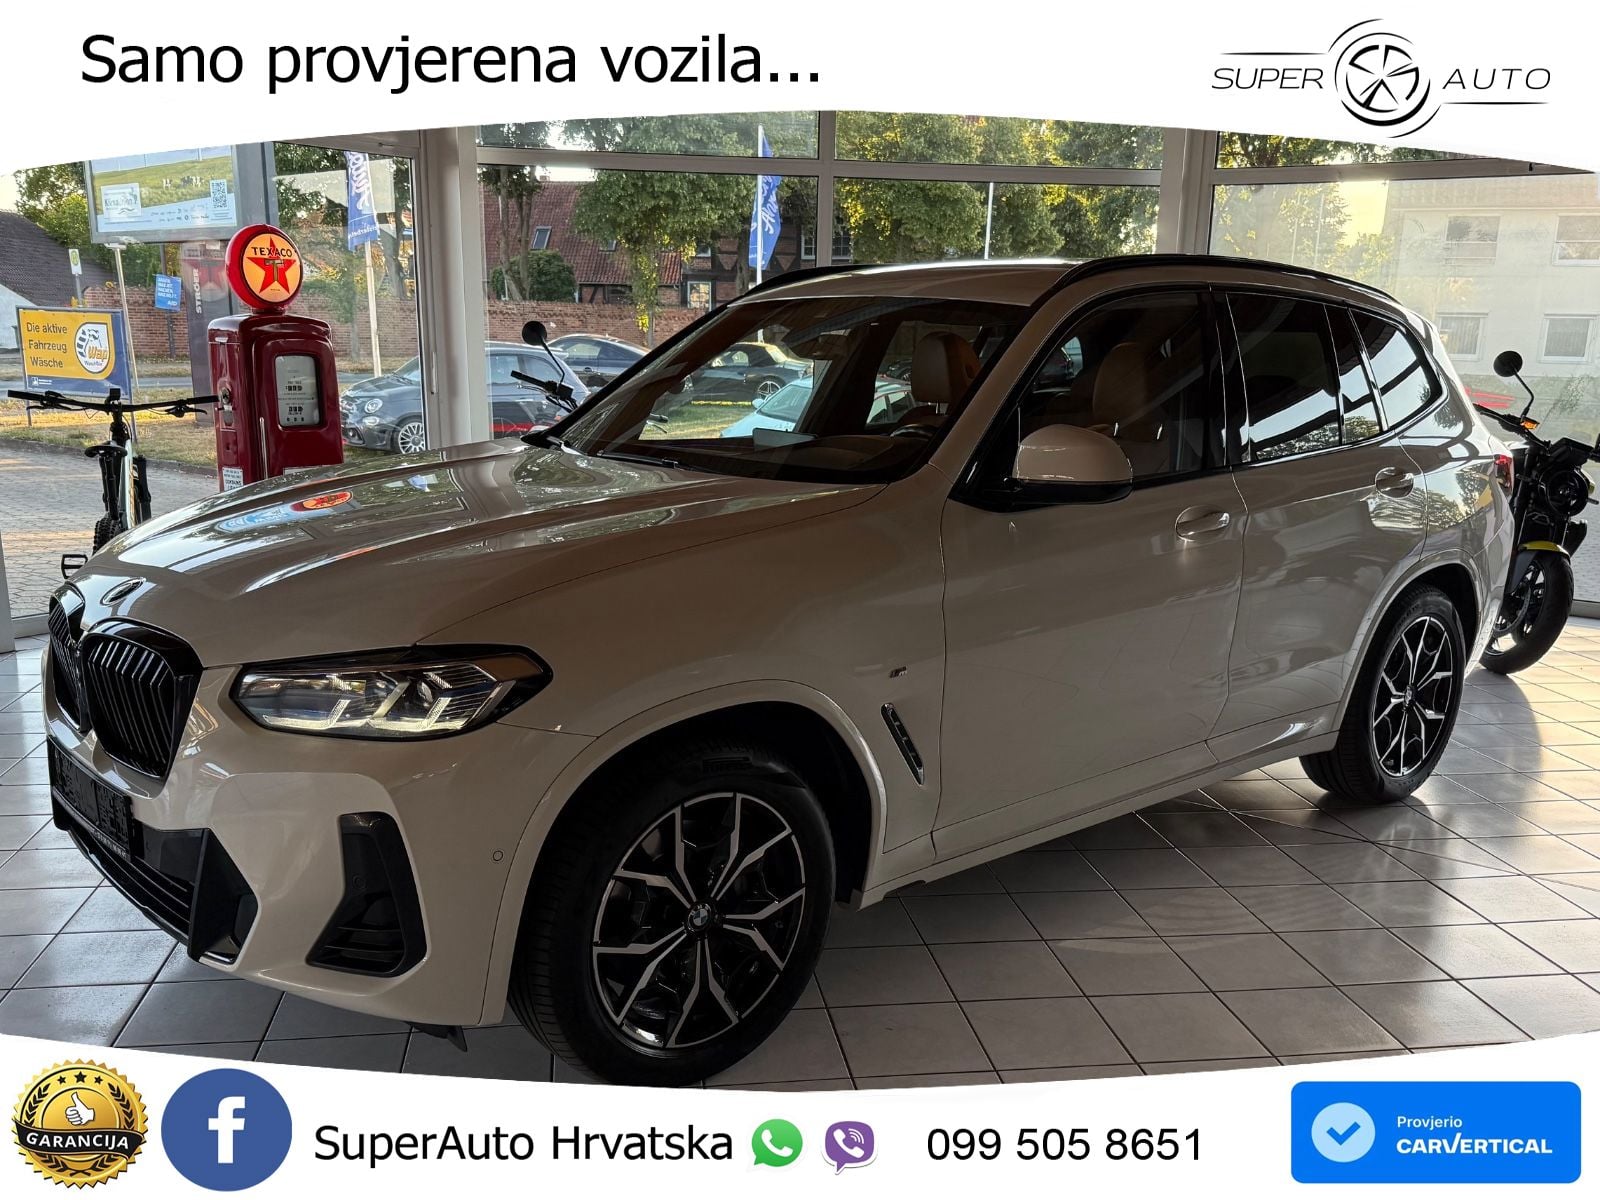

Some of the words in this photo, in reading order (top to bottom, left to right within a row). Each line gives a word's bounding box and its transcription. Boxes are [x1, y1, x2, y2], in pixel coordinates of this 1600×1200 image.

[251, 246, 293, 258] TEXACO
[26, 322, 40, 332] Die
[42, 323, 68, 334] aktive
[28, 340, 67, 354] Fahrzeug
[30, 356, 64, 368] Wäsche
